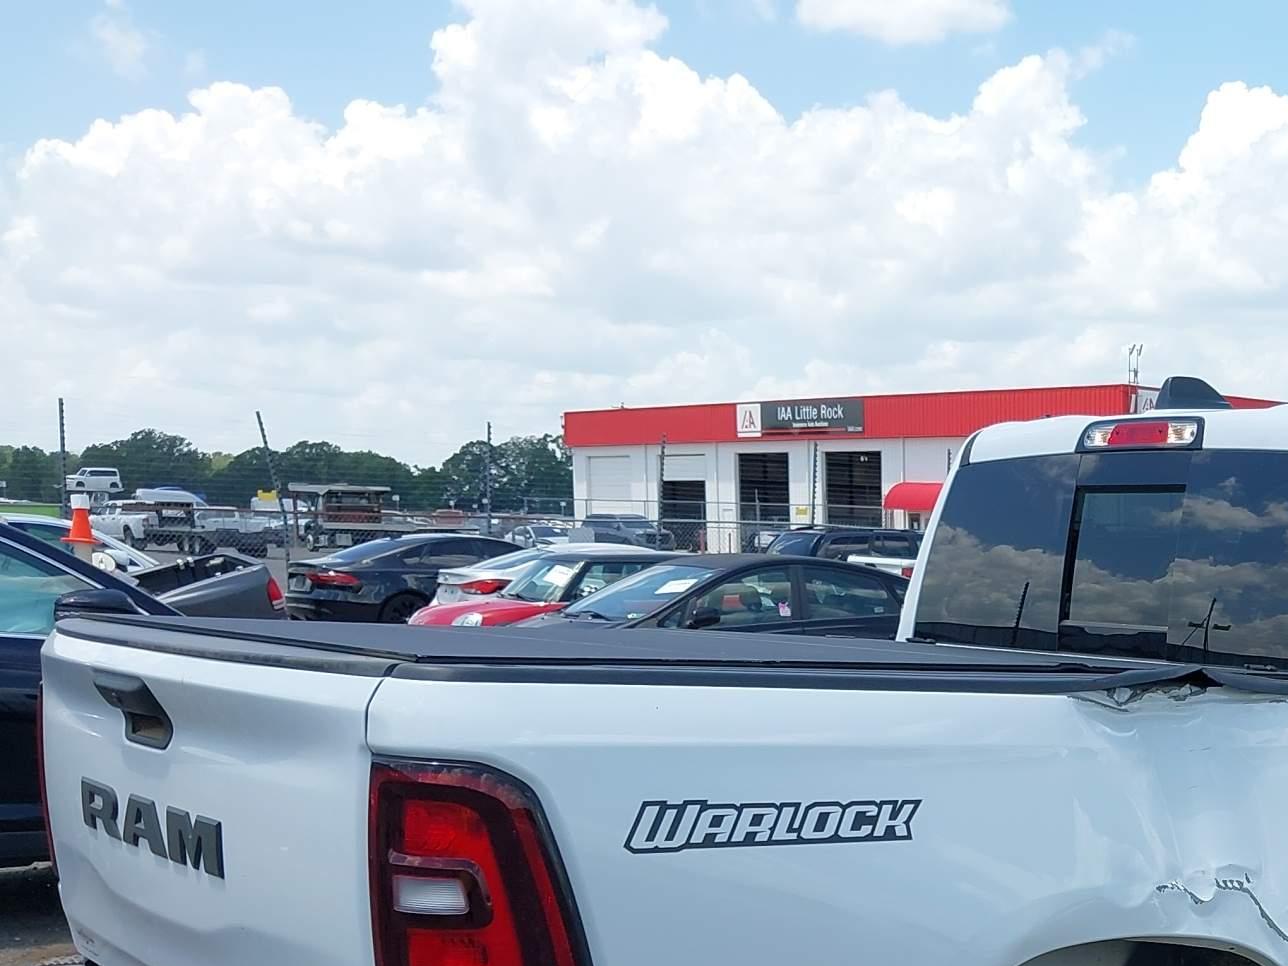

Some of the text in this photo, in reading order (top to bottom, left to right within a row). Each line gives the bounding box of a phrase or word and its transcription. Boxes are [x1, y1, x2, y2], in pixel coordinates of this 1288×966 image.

[777, 403, 845, 421] IAA Little Rock
[81, 776, 225, 880] RAM
[623, 799, 923, 854] WARLOCK
